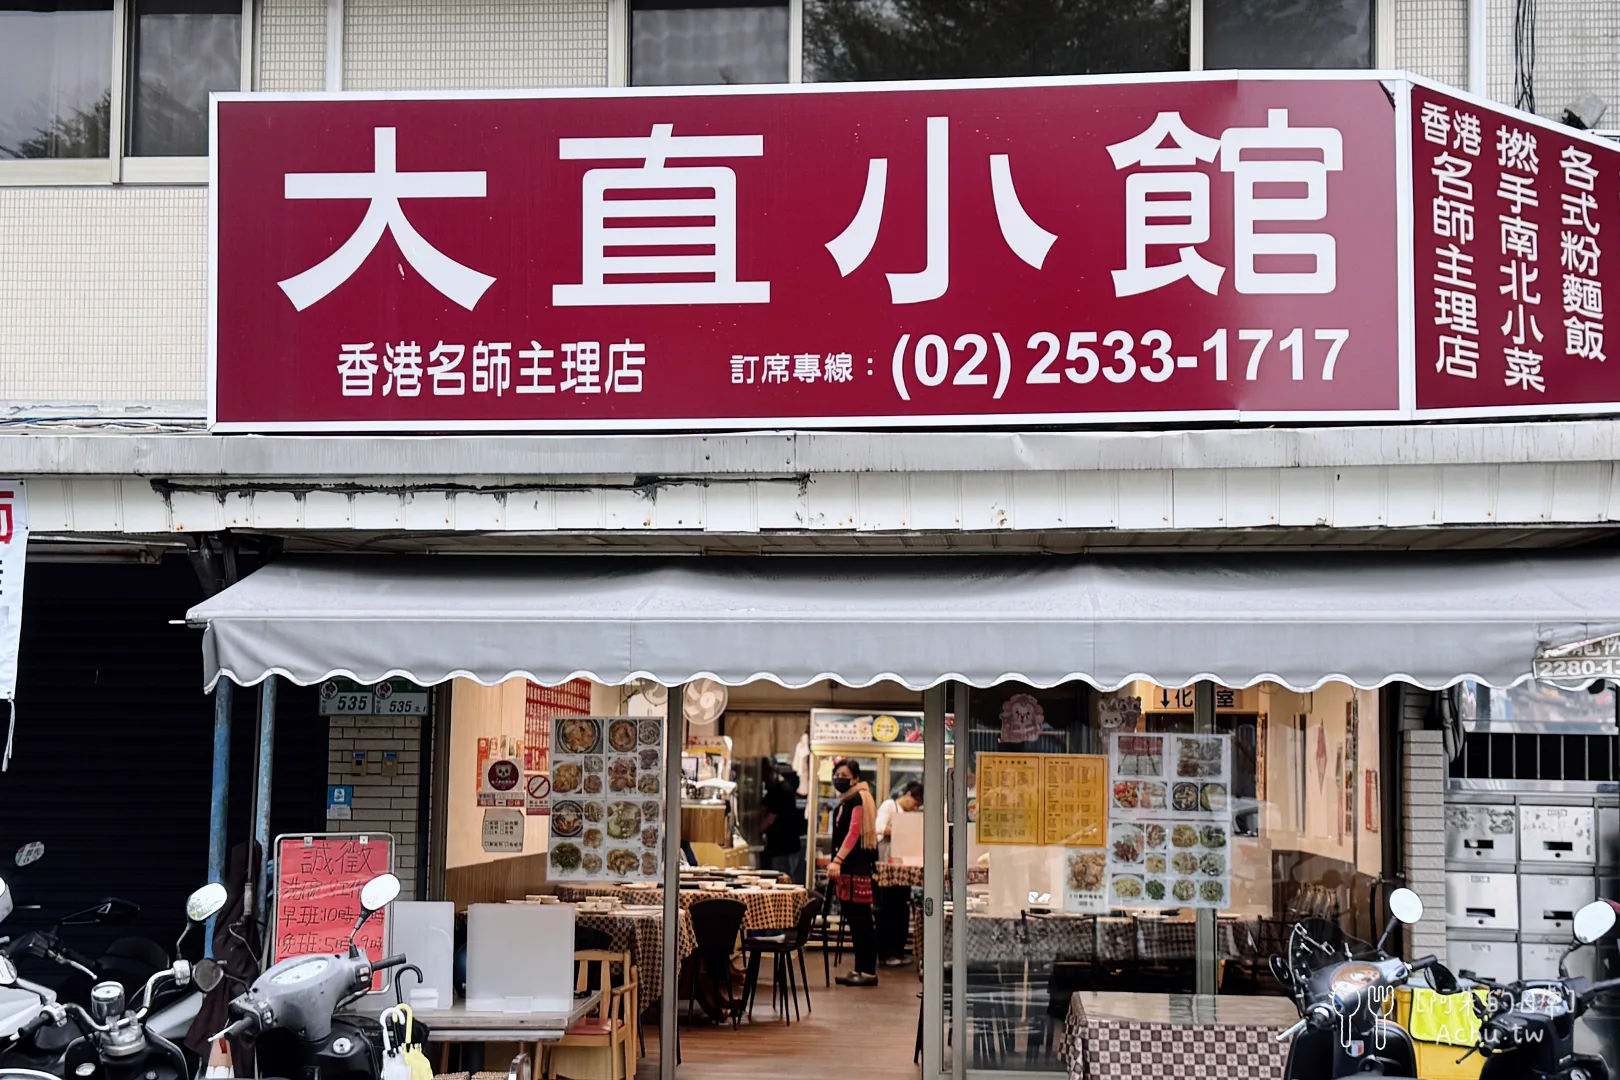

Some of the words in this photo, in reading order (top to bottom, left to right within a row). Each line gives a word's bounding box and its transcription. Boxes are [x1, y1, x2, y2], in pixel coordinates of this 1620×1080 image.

[277, 108, 1344, 311] 大直小館
[1559, 145, 1607, 362] 各式粉麵飯
[337, 339, 645, 396] 香港名師主理店
[892, 333, 1011, 400] (02)
[1026, 327, 1350, 384] 2533-1717
[337, 696, 367, 711] 535
[300, 842, 375, 875] 誠徵
